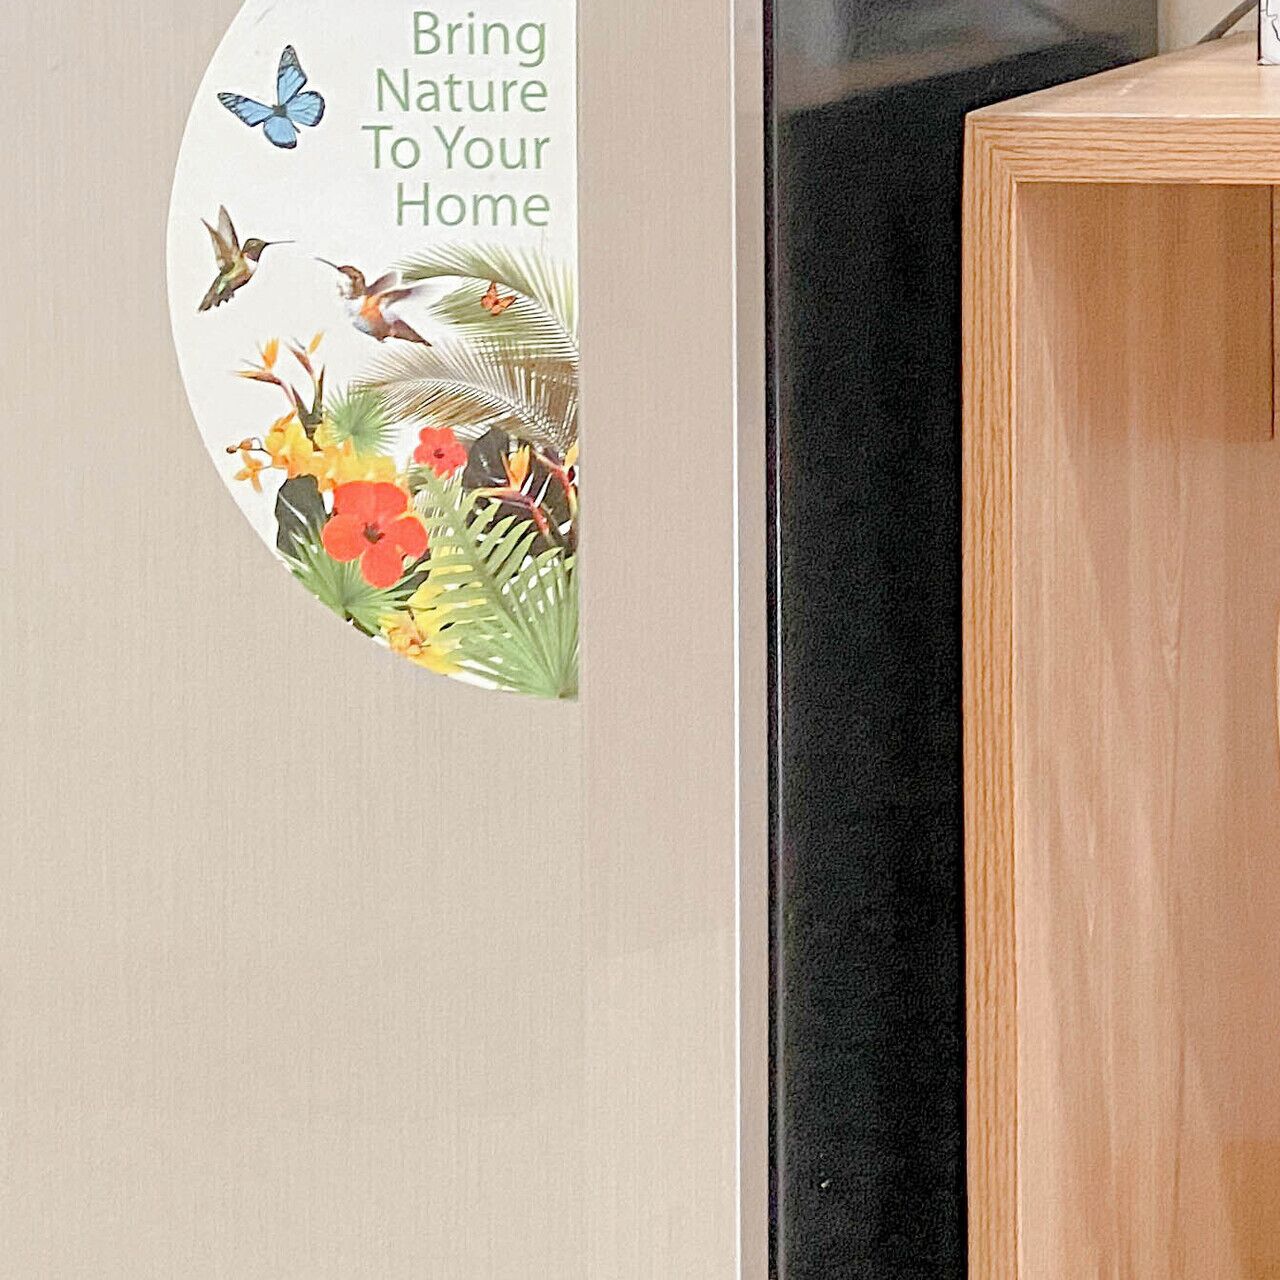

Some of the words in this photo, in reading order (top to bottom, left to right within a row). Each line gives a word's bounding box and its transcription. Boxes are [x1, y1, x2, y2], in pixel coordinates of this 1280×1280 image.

[413, 11, 546, 68] Bring
[377, 68, 548, 112] Nature
[361, 125, 420, 169] To
[433, 125, 550, 169] Your
[397, 182, 550, 227] Home
